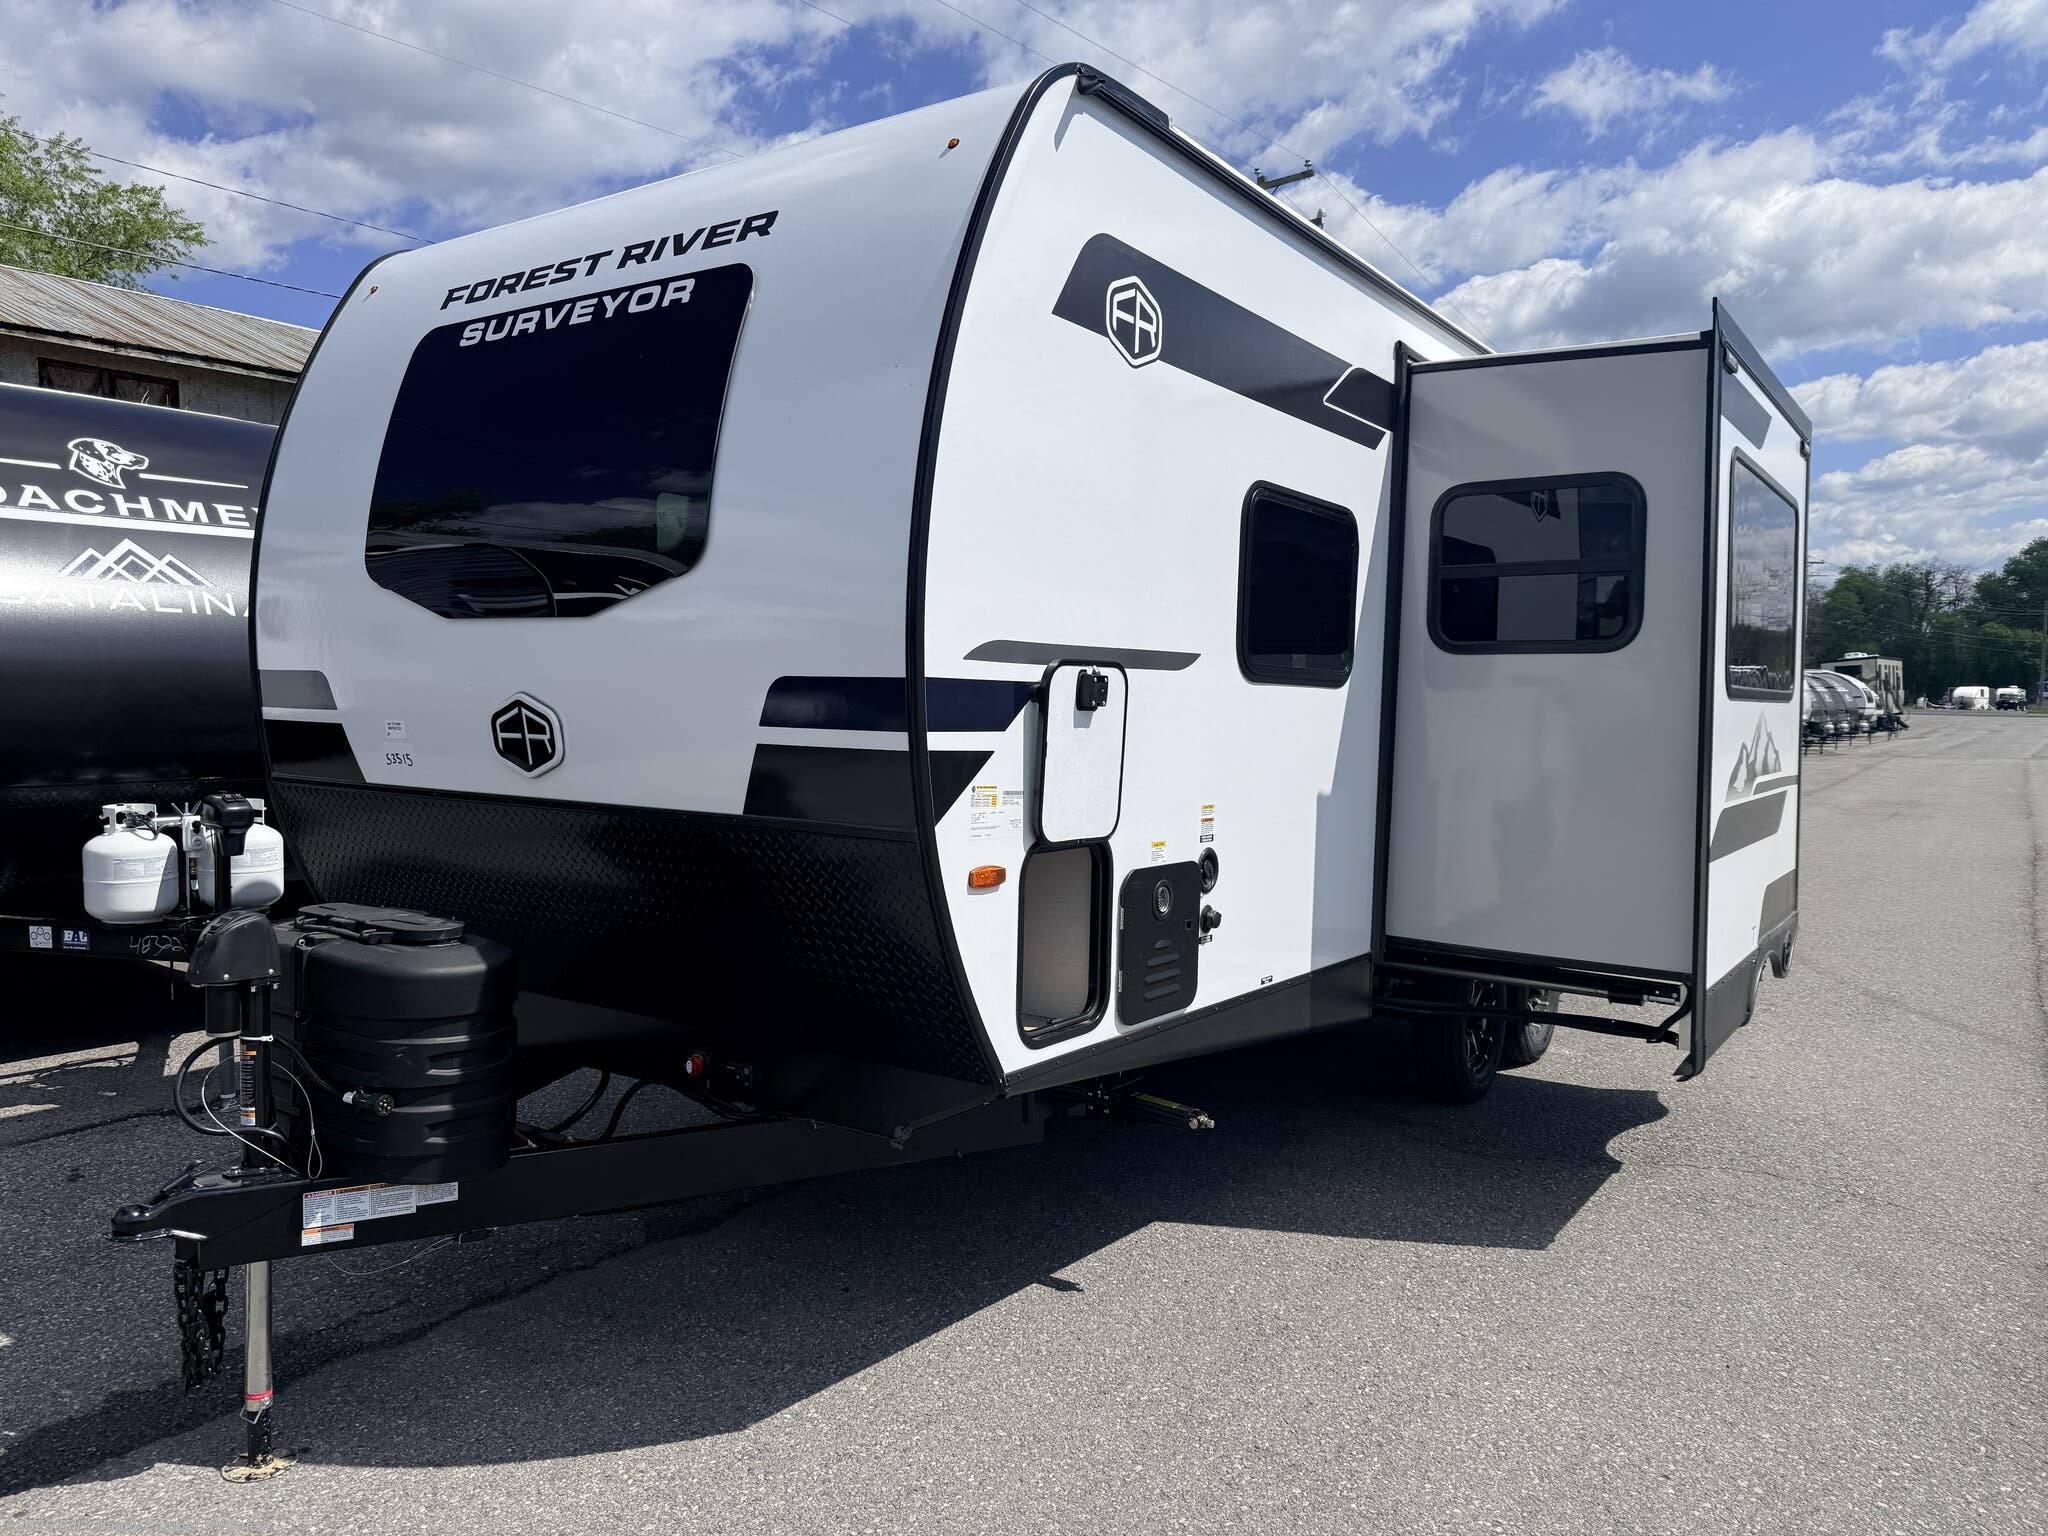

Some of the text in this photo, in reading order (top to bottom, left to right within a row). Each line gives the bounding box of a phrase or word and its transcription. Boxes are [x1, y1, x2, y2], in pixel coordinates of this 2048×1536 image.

[440, 210, 779, 311] FOREST RIVER
[459, 278, 696, 347] SURVEYOR
[0, 484, 258, 527] ACHME
